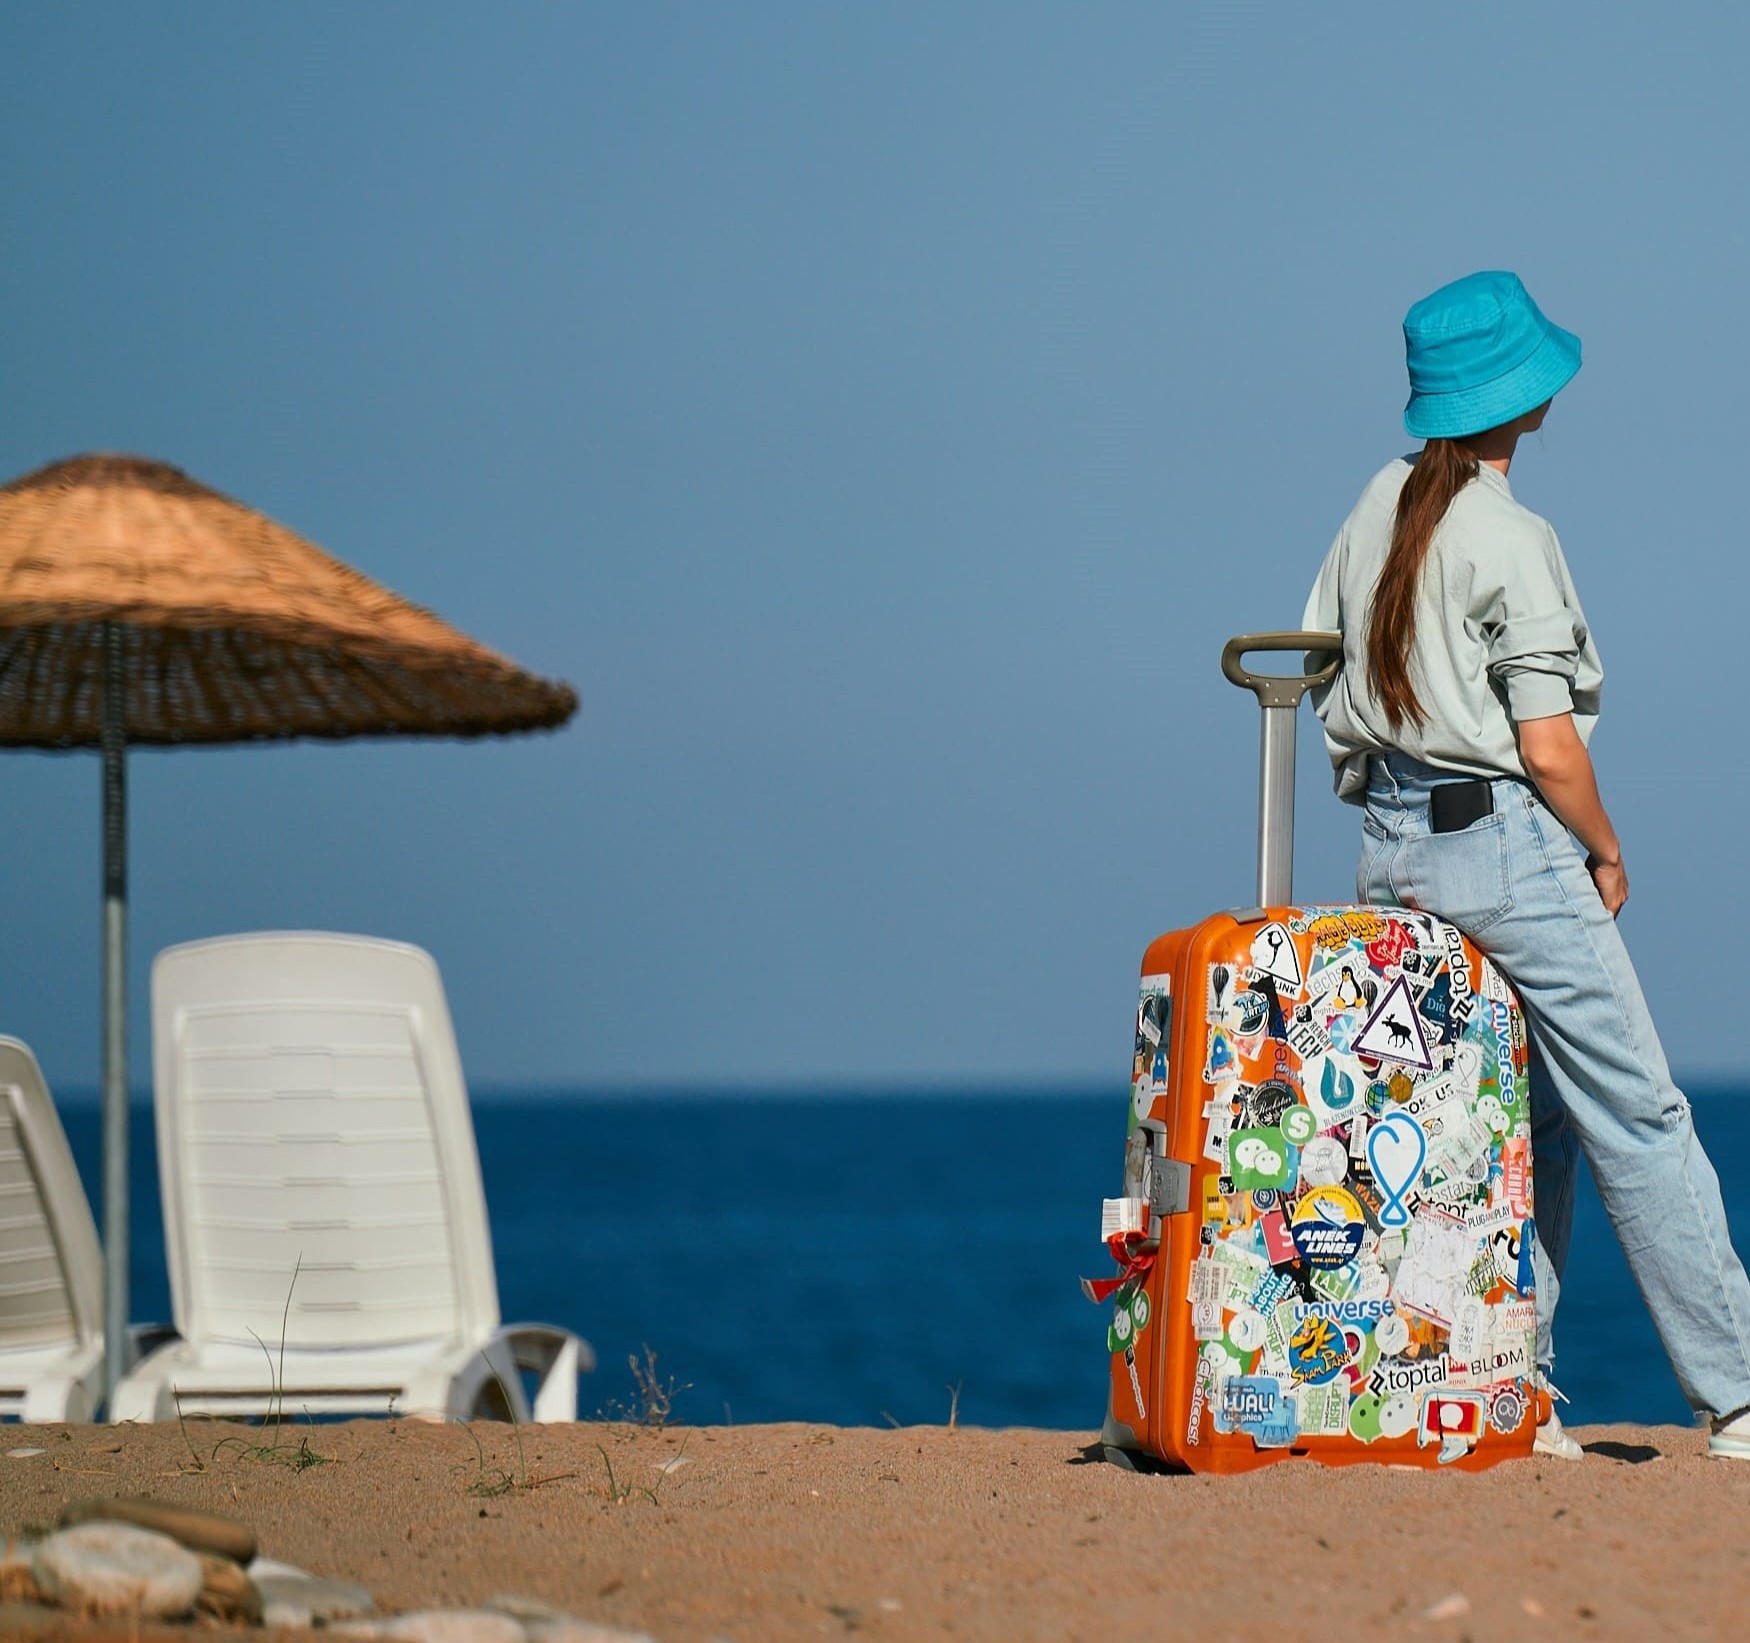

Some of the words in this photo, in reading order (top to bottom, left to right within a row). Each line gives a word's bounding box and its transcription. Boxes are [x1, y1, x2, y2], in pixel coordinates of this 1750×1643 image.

[1307, 952, 1369, 997] techsars
[1443, 927, 1470, 996] toptal
[1308, 1019, 1331, 1048] RENCH
[1496, 1002, 1515, 1105] niverse
[1287, 1111, 1310, 1139] S
[1297, 1230, 1351, 1242] ANEK
[1305, 1242, 1356, 1254] LINES
[1255, 1273, 1280, 1314] ABOUT
[1262, 1272, 1293, 1318] HARING
[1295, 1299, 1394, 1321] universe
[1321, 1350, 1352, 1372] PARK
[1388, 1357, 1447, 1393] toptal
[1471, 1347, 1525, 1376] BLOOM
